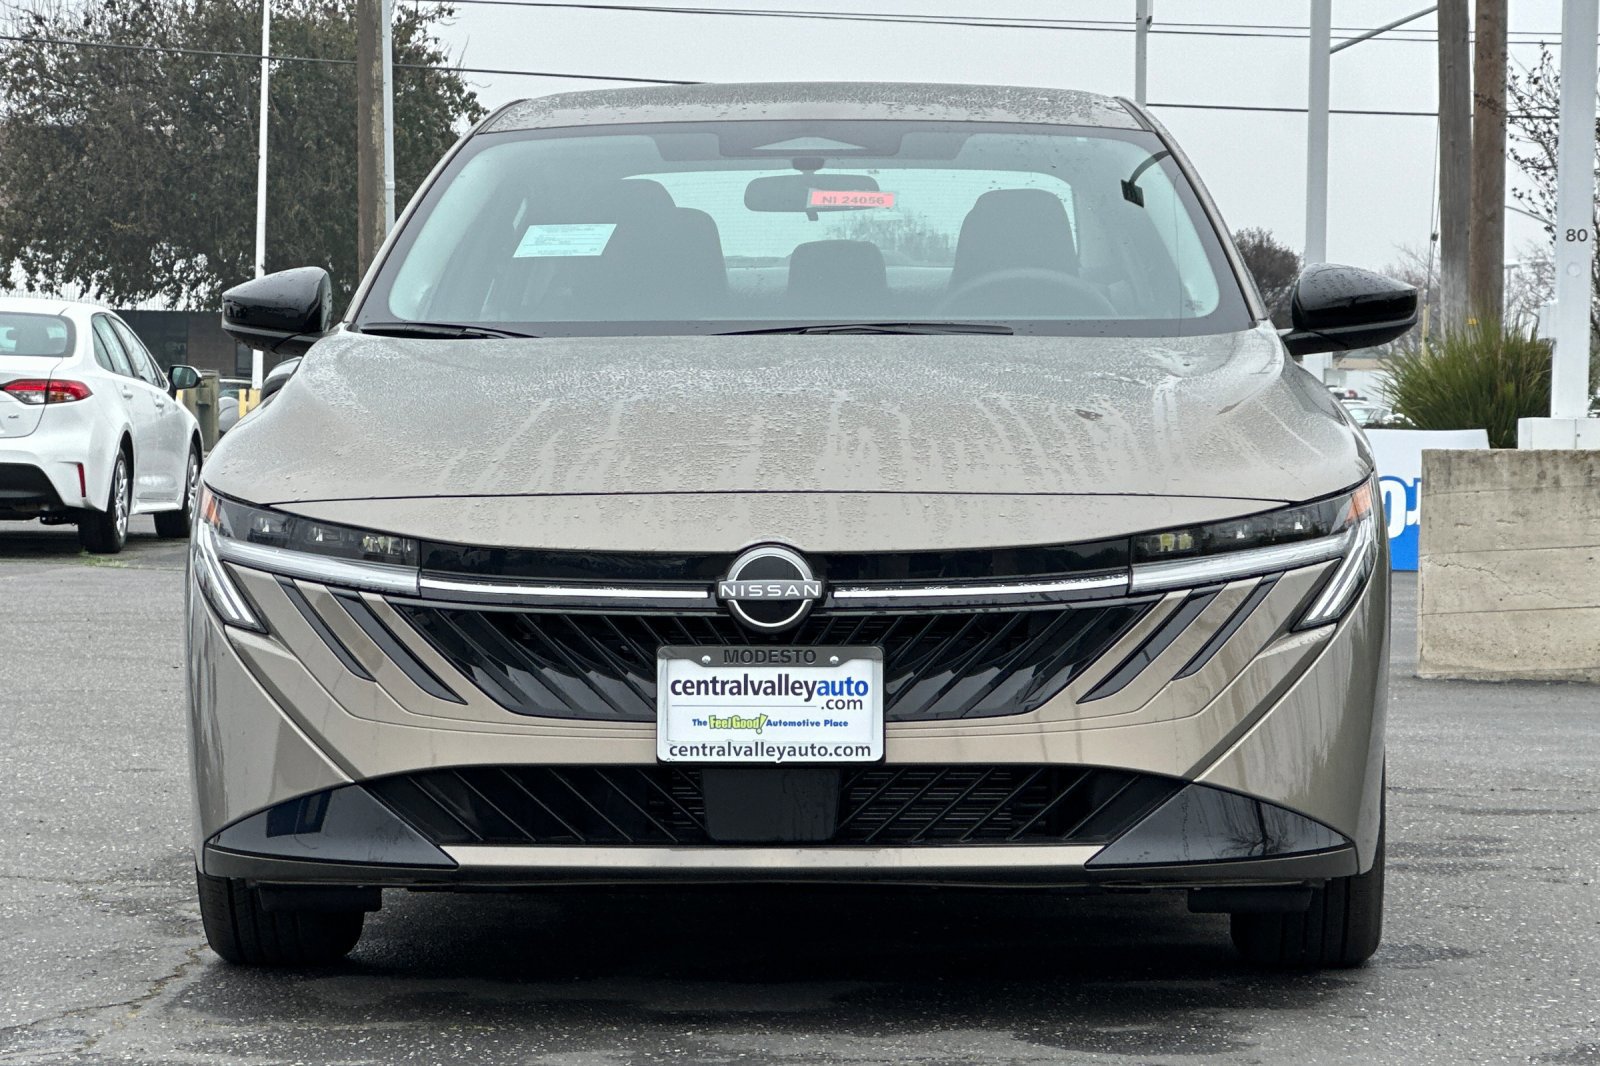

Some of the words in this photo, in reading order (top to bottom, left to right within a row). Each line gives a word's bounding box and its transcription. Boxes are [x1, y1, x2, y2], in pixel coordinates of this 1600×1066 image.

[1566, 228, 1588, 242] 80
[721, 584, 819, 597] NISSAN
[723, 649, 817, 664] MODESTO
[670, 673, 869, 702] centralvalleyauto
[820, 698, 863, 710] .com
[692, 718, 708, 727] The
[766, 719, 821, 728] Automotive
[823, 719, 849, 728] Place
[669, 742, 872, 761] centralvalleyauto.com
